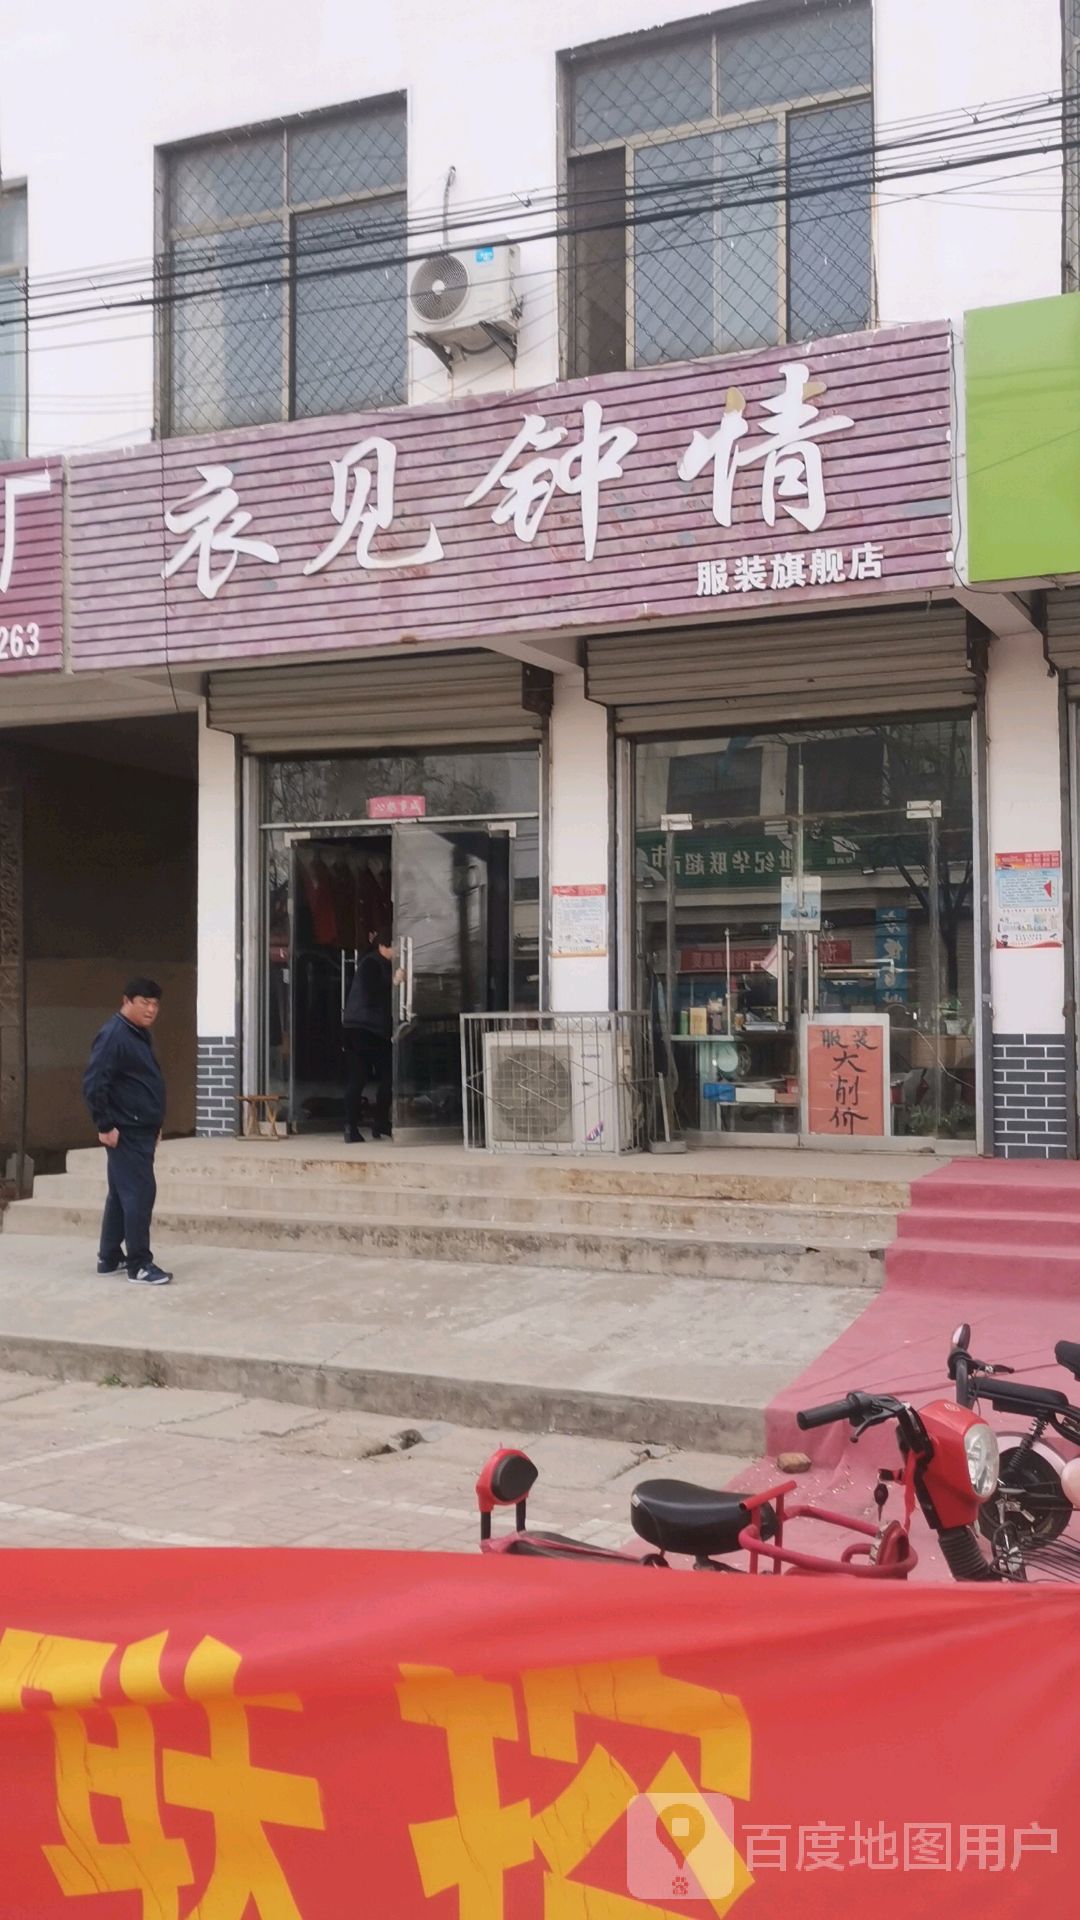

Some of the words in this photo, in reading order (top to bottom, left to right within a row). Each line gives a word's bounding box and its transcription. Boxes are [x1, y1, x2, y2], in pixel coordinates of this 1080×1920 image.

[161, 363, 854, 599] 衣见钟情
[696, 543, 885, 597] 服装旗舰店
[820, 1026, 879, 1049] 服装
